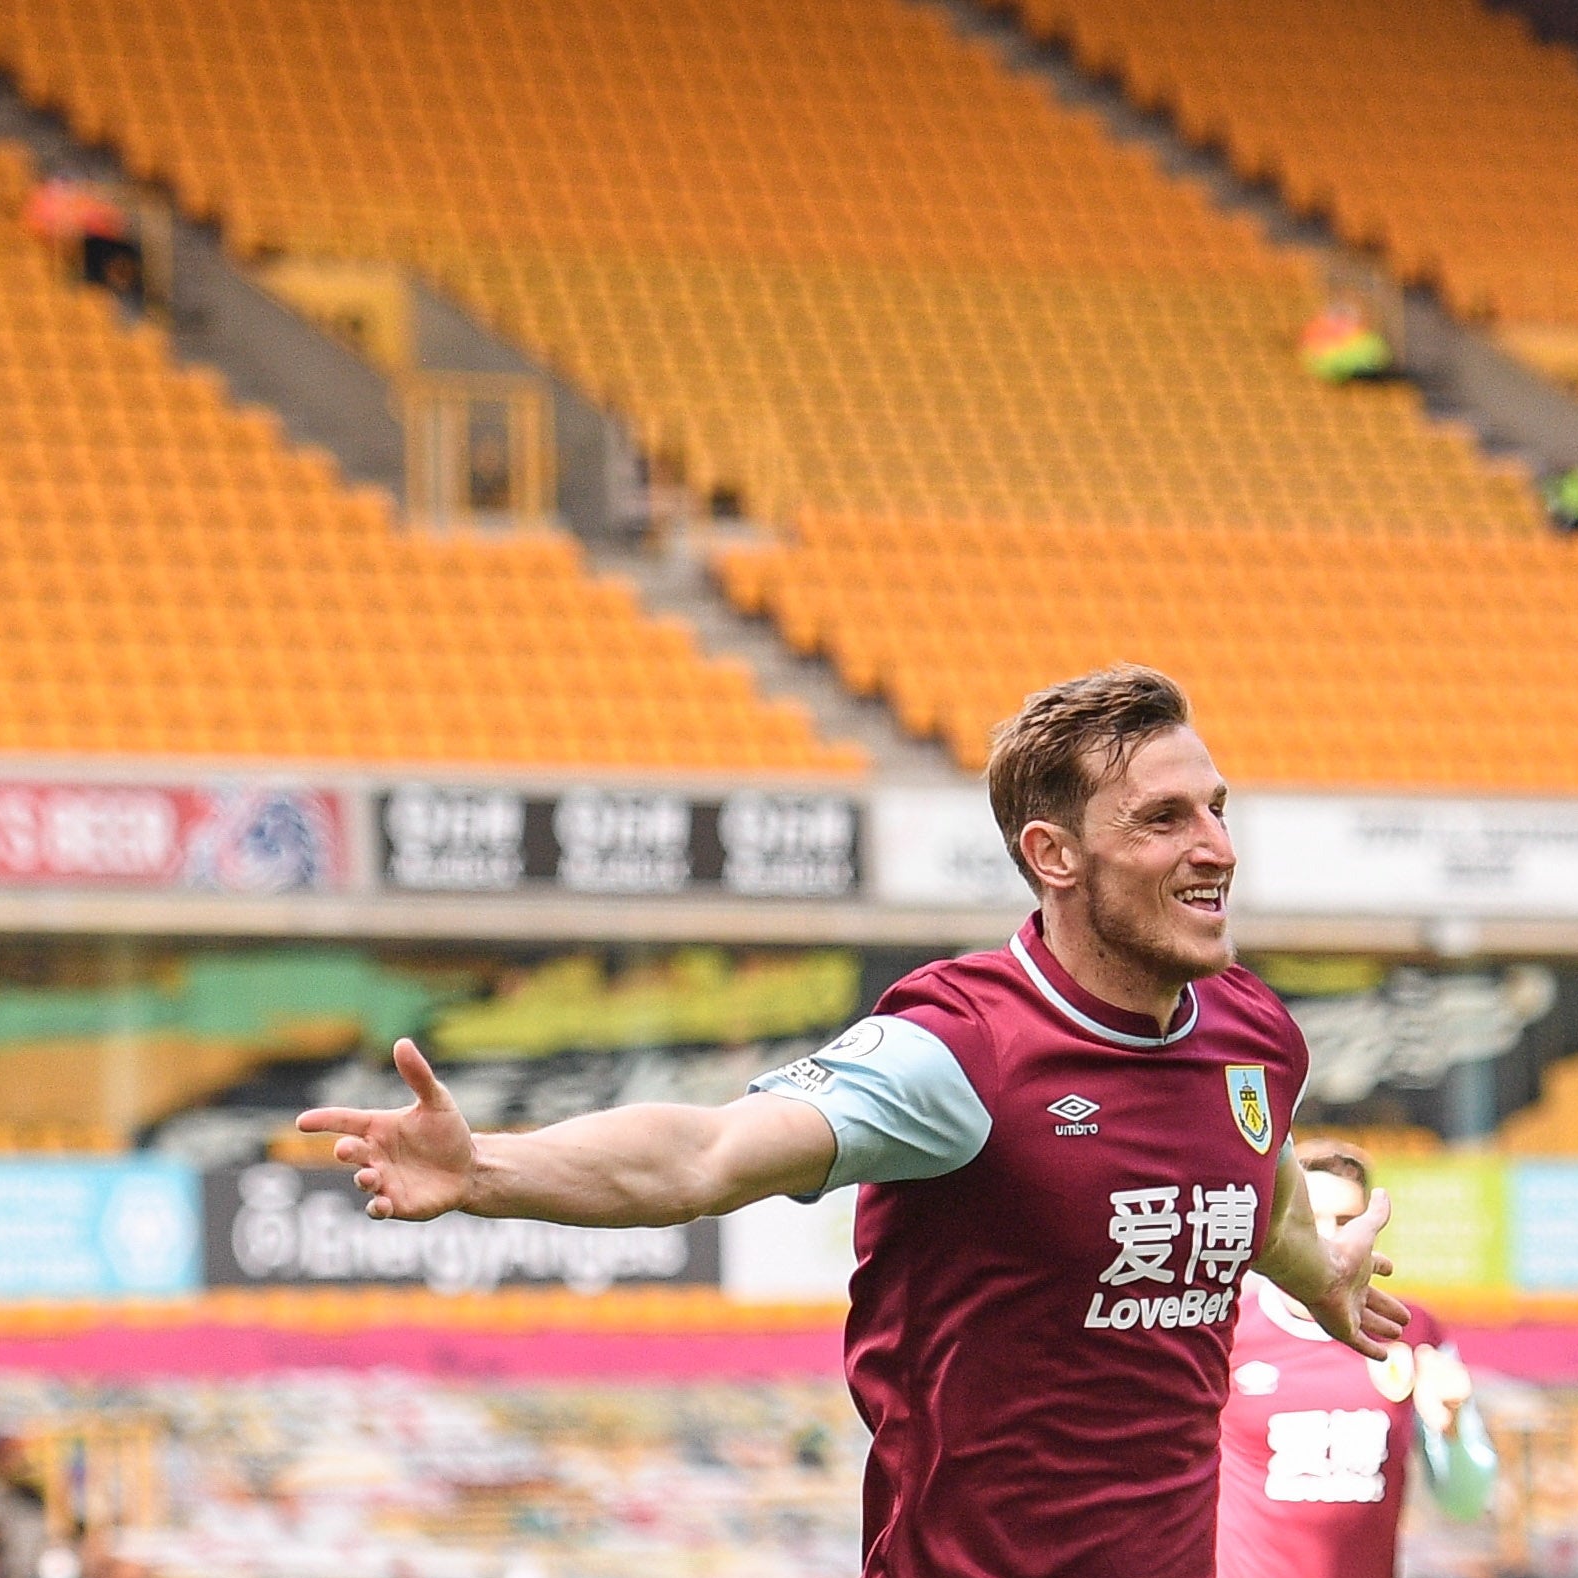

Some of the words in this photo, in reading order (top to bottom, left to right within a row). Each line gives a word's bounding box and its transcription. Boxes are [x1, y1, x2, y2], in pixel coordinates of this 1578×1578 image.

[1055, 1122, 1099, 1137] umbro
[1098, 1183, 1258, 1287] 爱博
[1083, 1286, 1234, 1330] LoveBet
